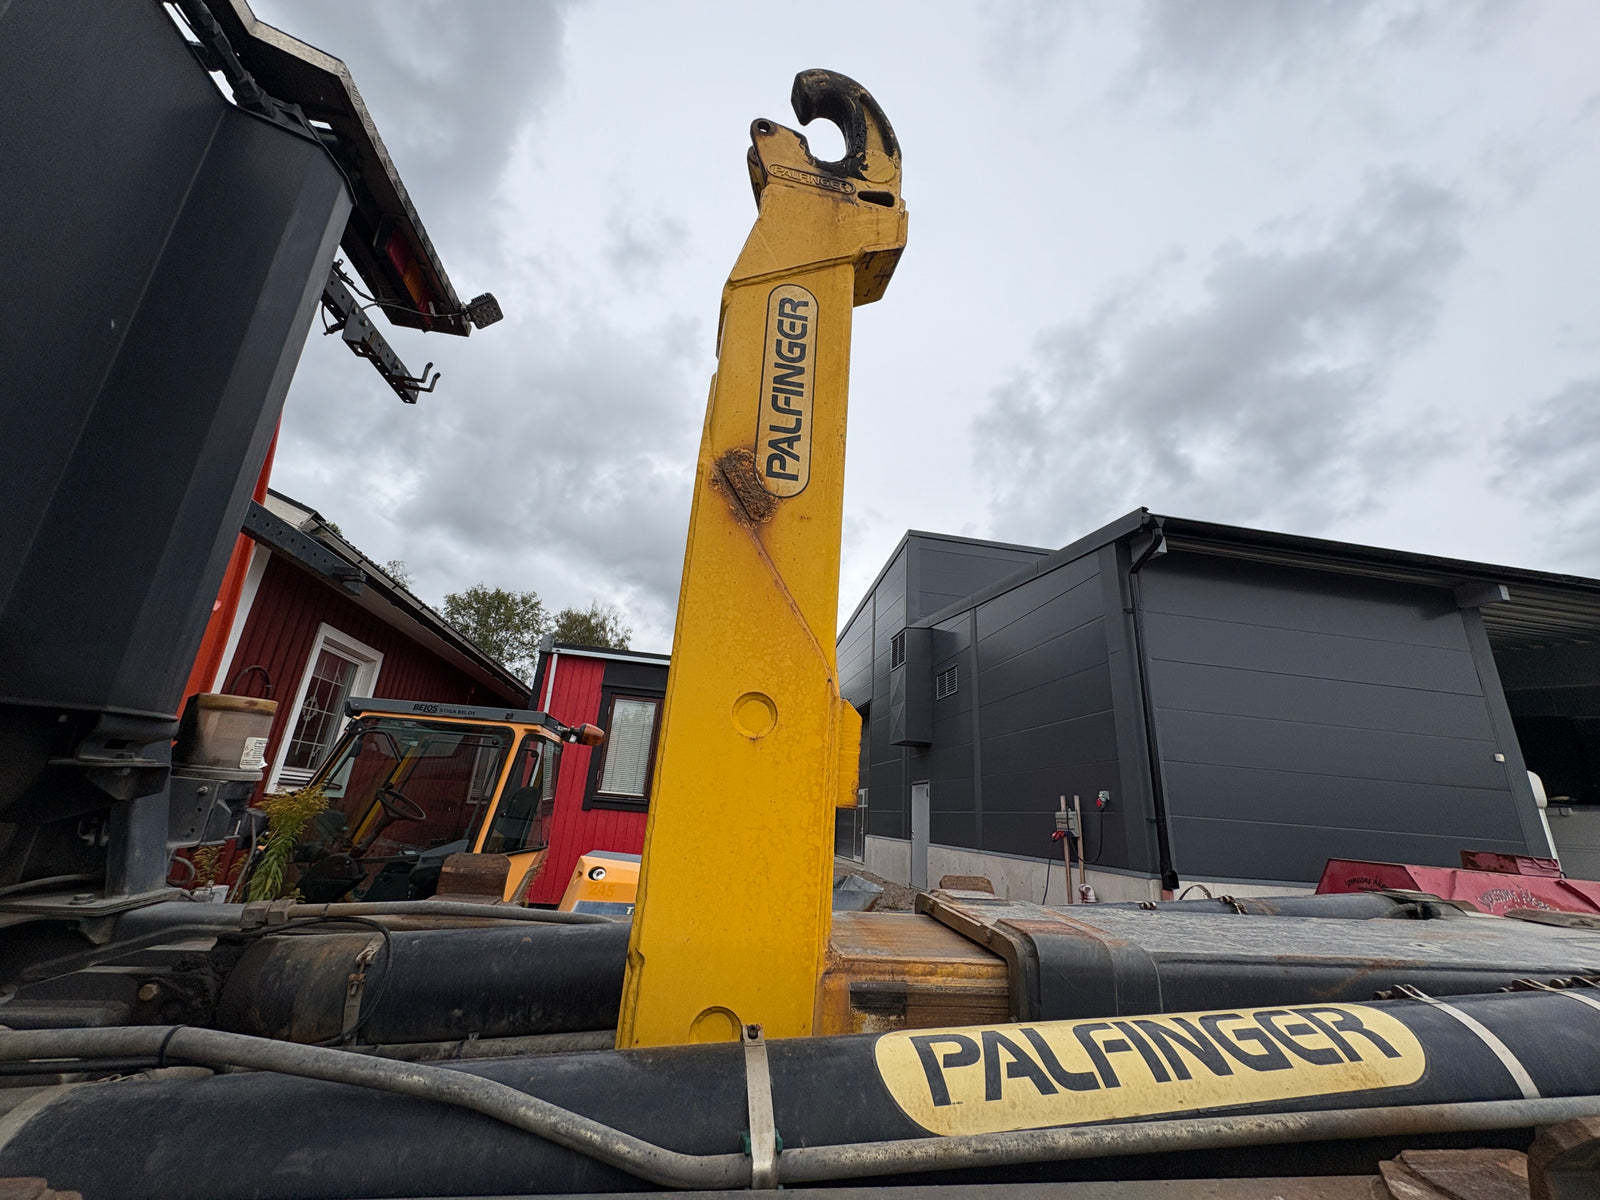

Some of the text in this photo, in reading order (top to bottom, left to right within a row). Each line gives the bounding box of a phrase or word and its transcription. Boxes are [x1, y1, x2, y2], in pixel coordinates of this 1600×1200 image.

[774, 166, 851, 192] PALFINGER
[766, 297, 809, 482] PALFINGER
[413, 703, 439, 714] BELOS
[588, 883, 615, 897] 245
[908, 1007, 1402, 1107] PALFINGER
